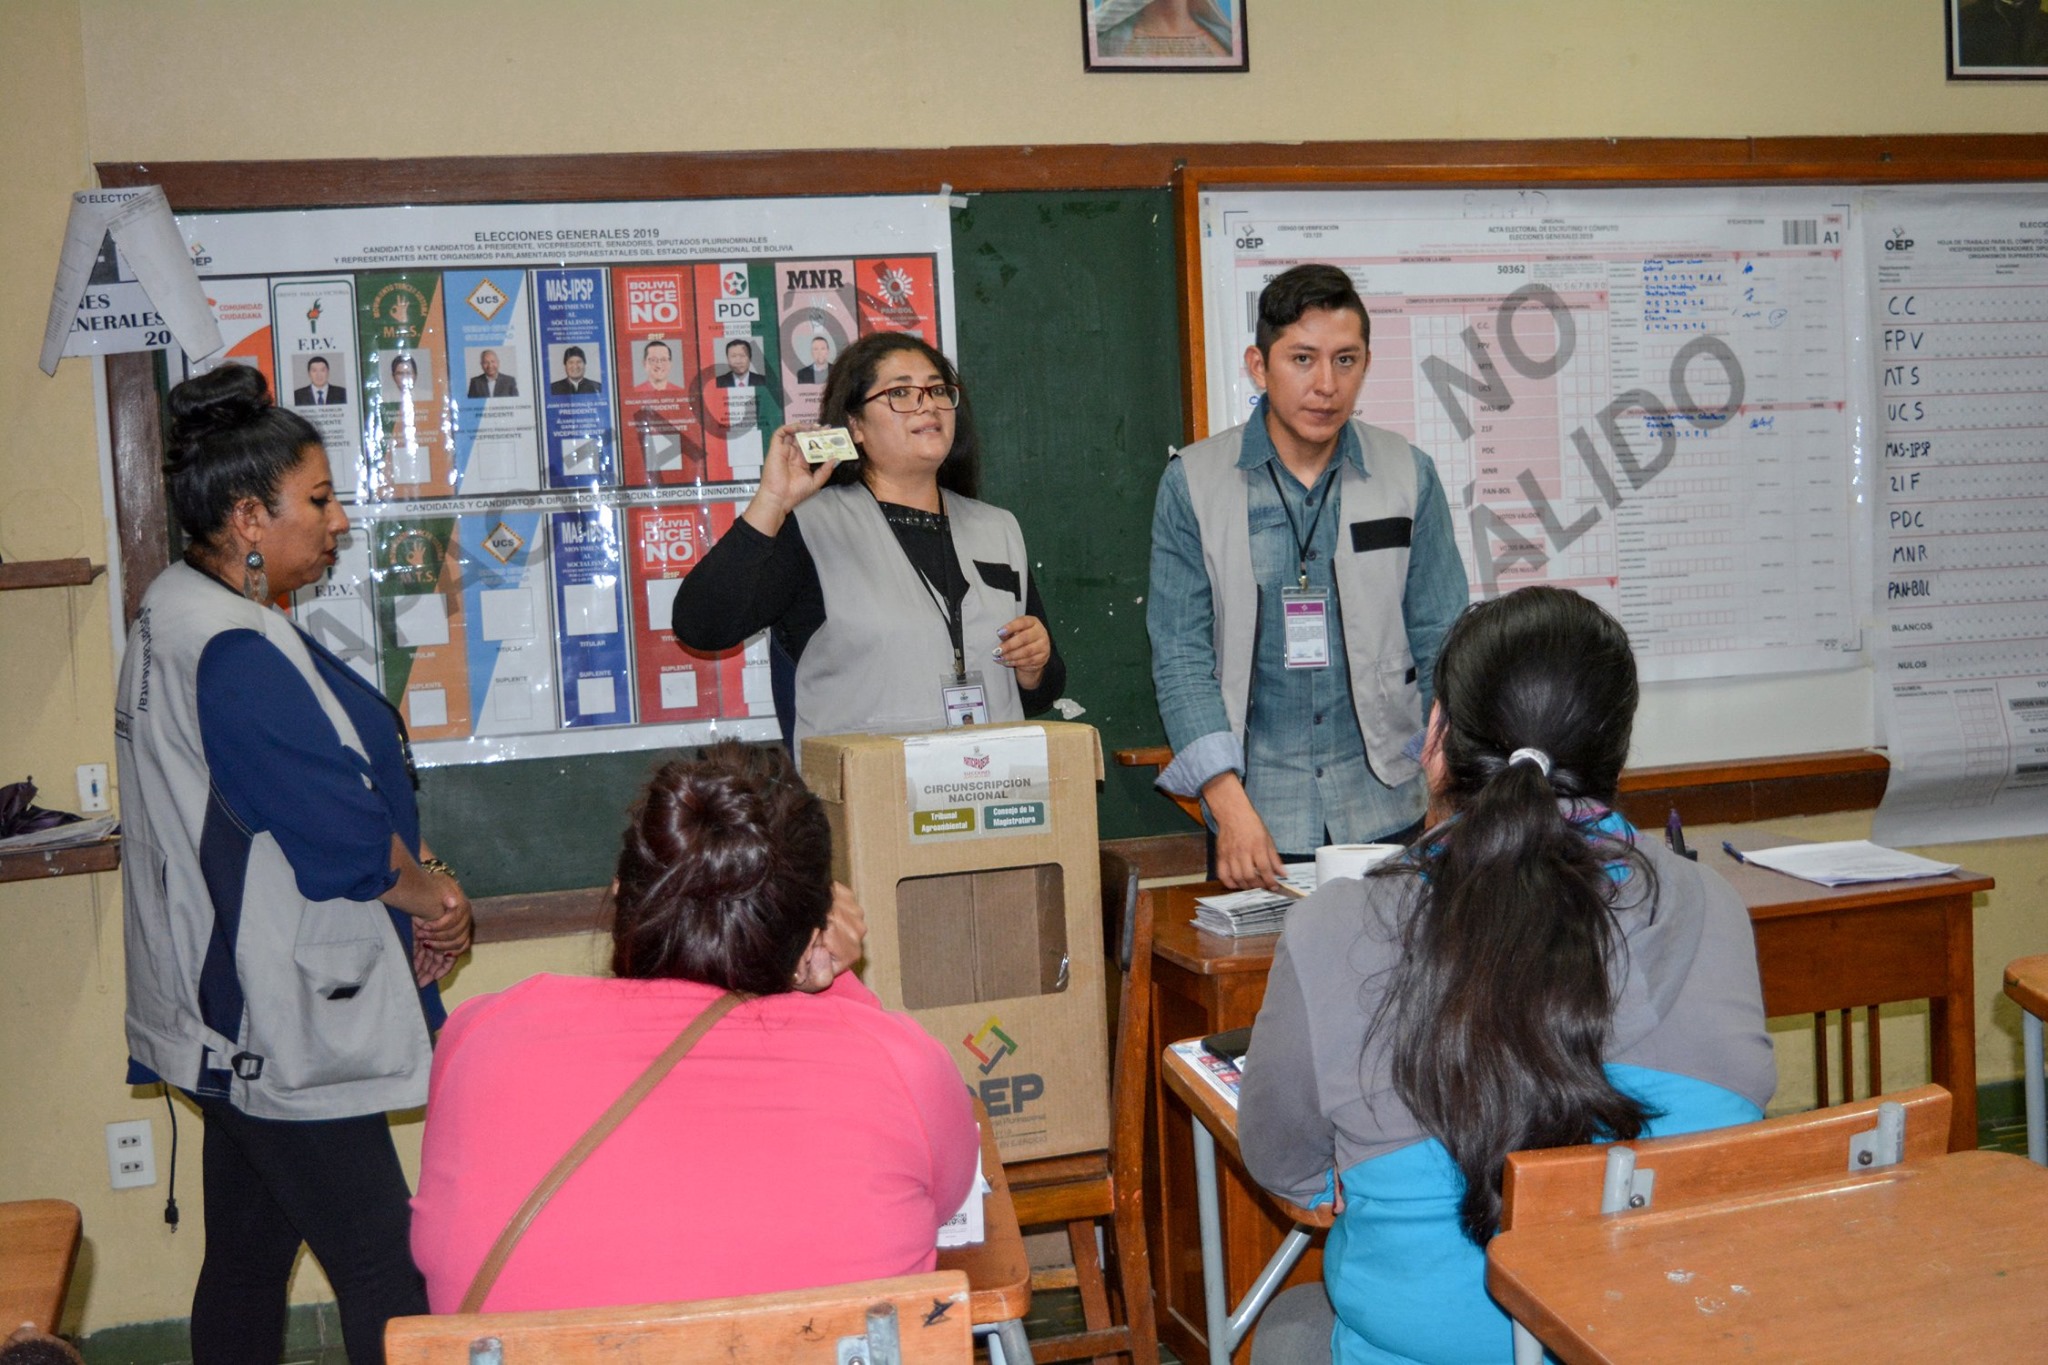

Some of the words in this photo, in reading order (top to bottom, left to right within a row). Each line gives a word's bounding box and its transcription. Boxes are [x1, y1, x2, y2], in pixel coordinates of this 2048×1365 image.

[475, 230, 554, 242] ELECCIONES
[556, 229, 630, 241] GENERALES
[633, 228, 660, 239] 2019
[1488, 226, 1504, 234] ACTA
[1505, 225, 1538, 234] ELECTORAL
[1538, 225, 1547, 233] DE
[1235, 237, 1264, 250] OEP
[1509, 233, 1544, 241] ELECCIONES
[1823, 231, 1840, 244] A1
[363, 245, 416, 254] CANDIDATAS
[424, 243, 476, 252] CANDIDATOS
[477, 242, 483, 250] A
[657, 238, 701, 246] DIPUTADOS
[702, 236, 768, 245] PLURINOMINALES
[1884, 239, 1915, 251] OEP
[341, 254, 416, 264] REPRESENTANTES
[417, 253, 439, 261] ANTE
[440, 252, 494, 261] ORGANISMOS
[495, 250, 567, 259] PARLAMENTARIOS
[568, 247, 639, 258] SUPRAESTATALES
[640, 246, 655, 255] DEL
[657, 246, 688, 255] ESTADO
[689, 245, 750, 254] PLURINACIONAL
[763, 244, 793, 252] BOLIVIA
[1497, 264, 1526, 275] 50362
[629, 280, 676, 291] BOLIVIA
[786, 269, 845, 290] MNR
[545, 278, 594, 302] MAS-IPSP
[476, 295, 500, 305] UCS
[629, 290, 678, 304] DICE
[219, 303, 264, 312] COMUNIDAD
[549, 303, 594, 311] MOVIMIENTO
[630, 303, 679, 324] NO
[718, 302, 755, 318] PDC
[219, 311, 263, 320] CIUDADANA
[144, 330, 172, 346] 20
[298, 336, 337, 350] F.P.V.
[1884, 329, 1924, 351] FPV
[1420, 282, 1577, 443] NO
[558, 407, 598, 415] PRESIDENTE
[1888, 401, 1924, 422] UCS
[1481, 447, 1495, 455] PDC
[1884, 441, 1931, 459] MAS-IPSP
[1482, 467, 1498, 475] MNR
[1890, 472, 1921, 492] 21F
[1482, 488, 1511, 496] PAN-BOL
[405, 501, 466, 512] CANDIDATAS
[475, 498, 535, 509] CANDIDATOS
[545, 494, 600, 505] DIPUTADOS
[644, 519, 691, 530] BOLIVIA
[1890, 510, 1925, 530] PDC
[645, 528, 693, 543] DICE
[492, 539, 515, 549] UCS
[646, 541, 693, 563] NO
[1892, 544, 1929, 564] MNR
[314, 583, 353, 598] F.P.V.
[1891, 622, 1933, 633] BLANCOS
[579, 639, 606, 648] TITULAR
[660, 663, 693, 672] SUPLENTE
[1897, 660, 1927, 670] NULOS
[579, 670, 612, 678] SUPLENTE
[924, 777, 1031, 794] CIRCUNSCRIPCIÓN
[948, 790, 1009, 803] NACIONAL
[931, 811, 958, 821] Tribunal
[993, 806, 1018, 816] Consejo
[1019, 805, 1027, 813] de
[1028, 804, 1035, 812] la
[921, 821, 968, 833] Agroambiental
[993, 816, 1036, 827] Magistratura
[967, 1073, 1044, 1117] EP
